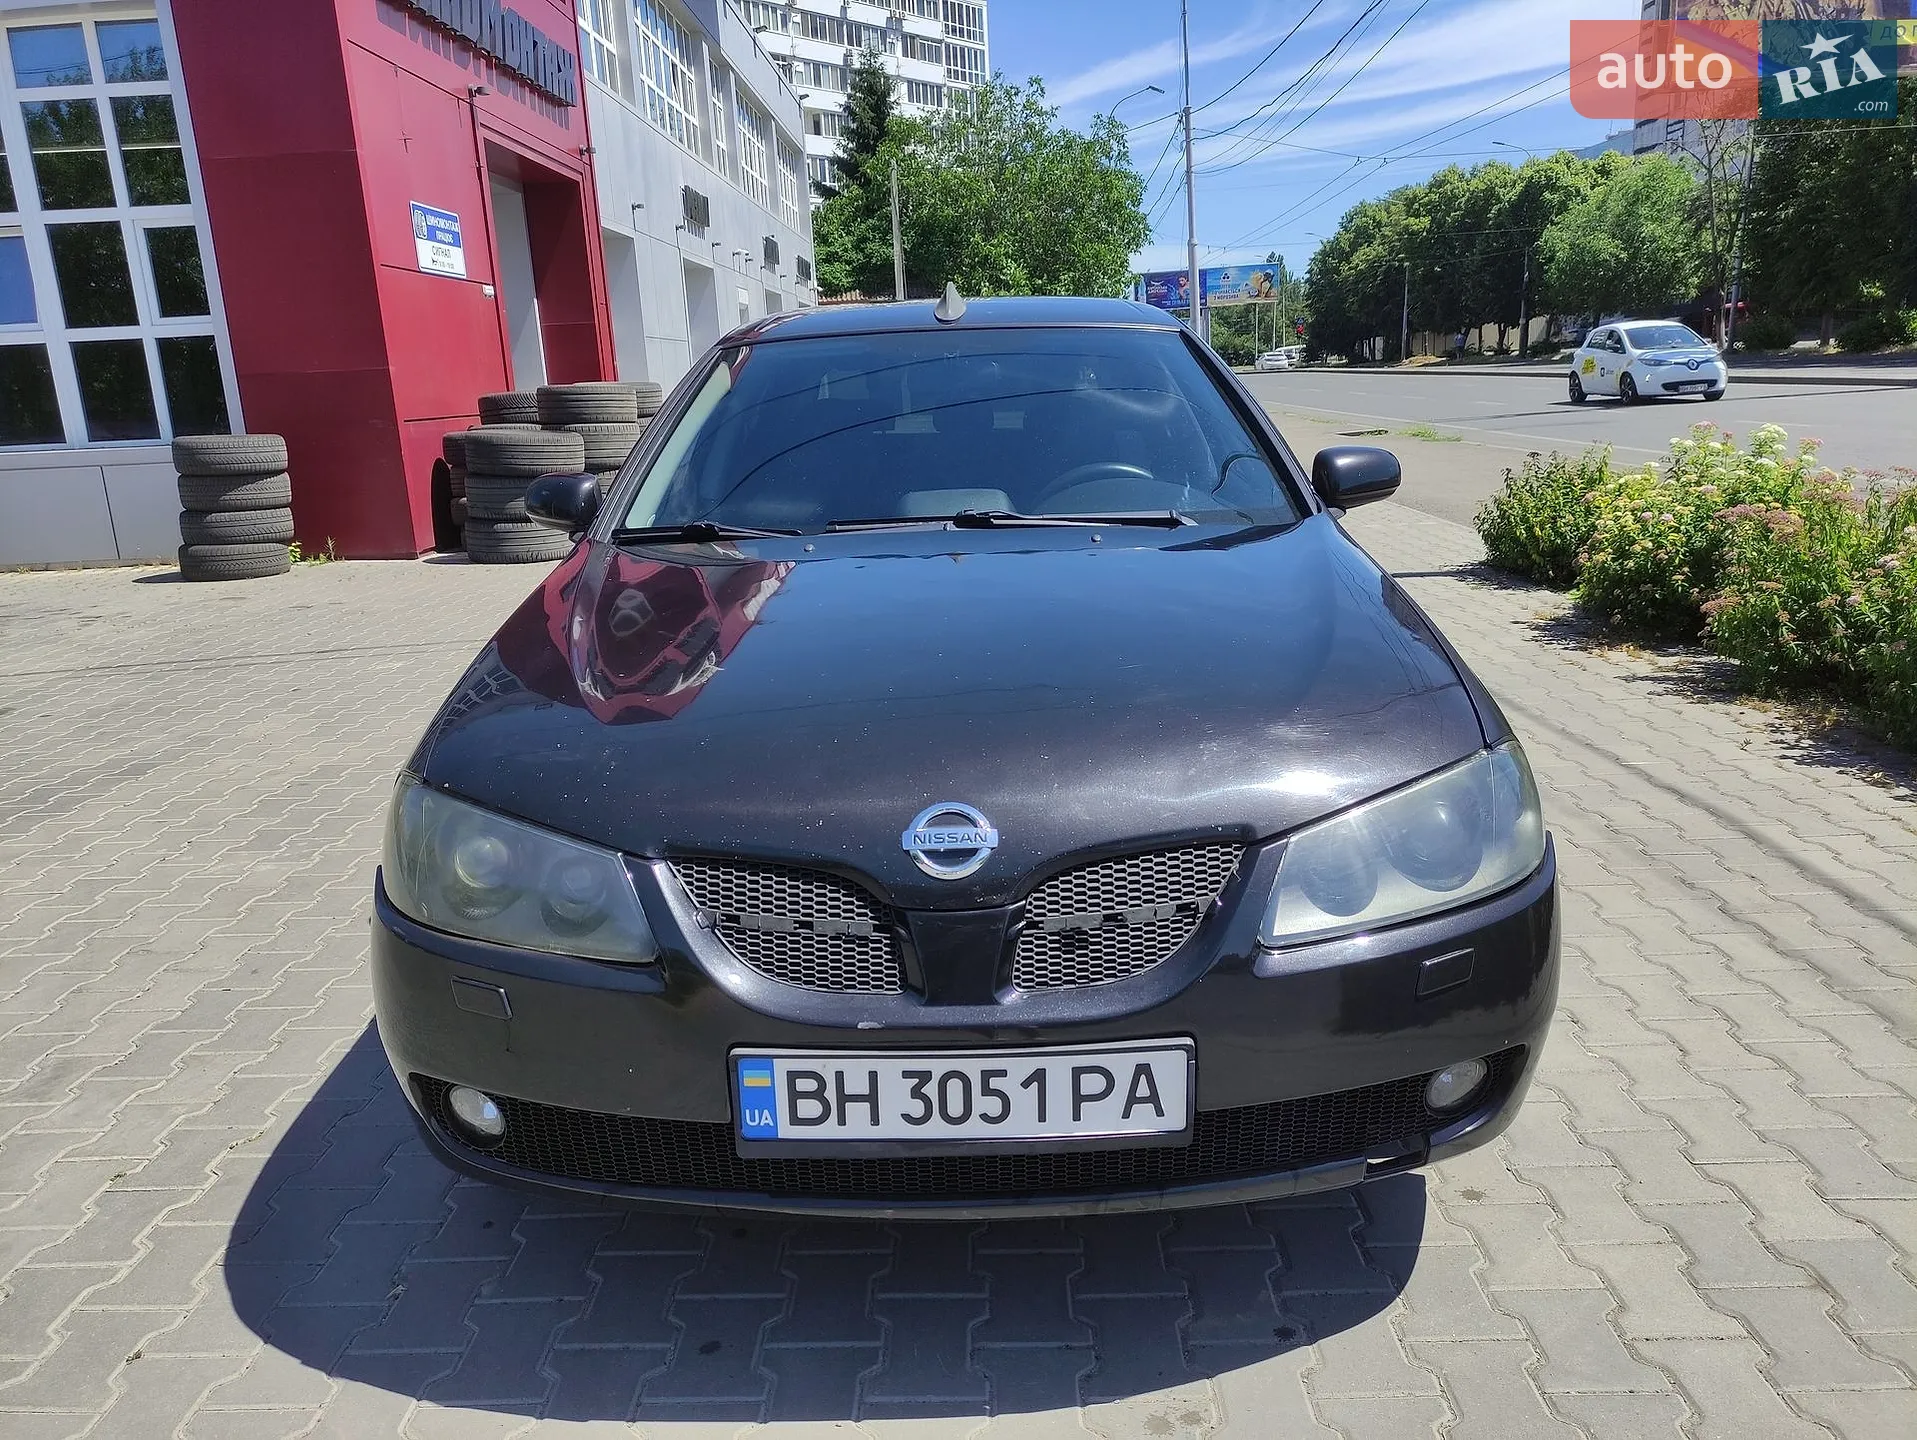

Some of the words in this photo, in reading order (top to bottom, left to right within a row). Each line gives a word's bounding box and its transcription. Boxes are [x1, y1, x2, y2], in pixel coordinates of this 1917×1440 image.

[398, 0, 577, 107] ОМОНТАЖ
[911, 831, 989, 847] NISSAN
[744, 1108, 775, 1128] UA
[785, 1068, 881, 1128] BH
[899, 1066, 1048, 1127] 3051
[1071, 1062, 1166, 1123] PA
